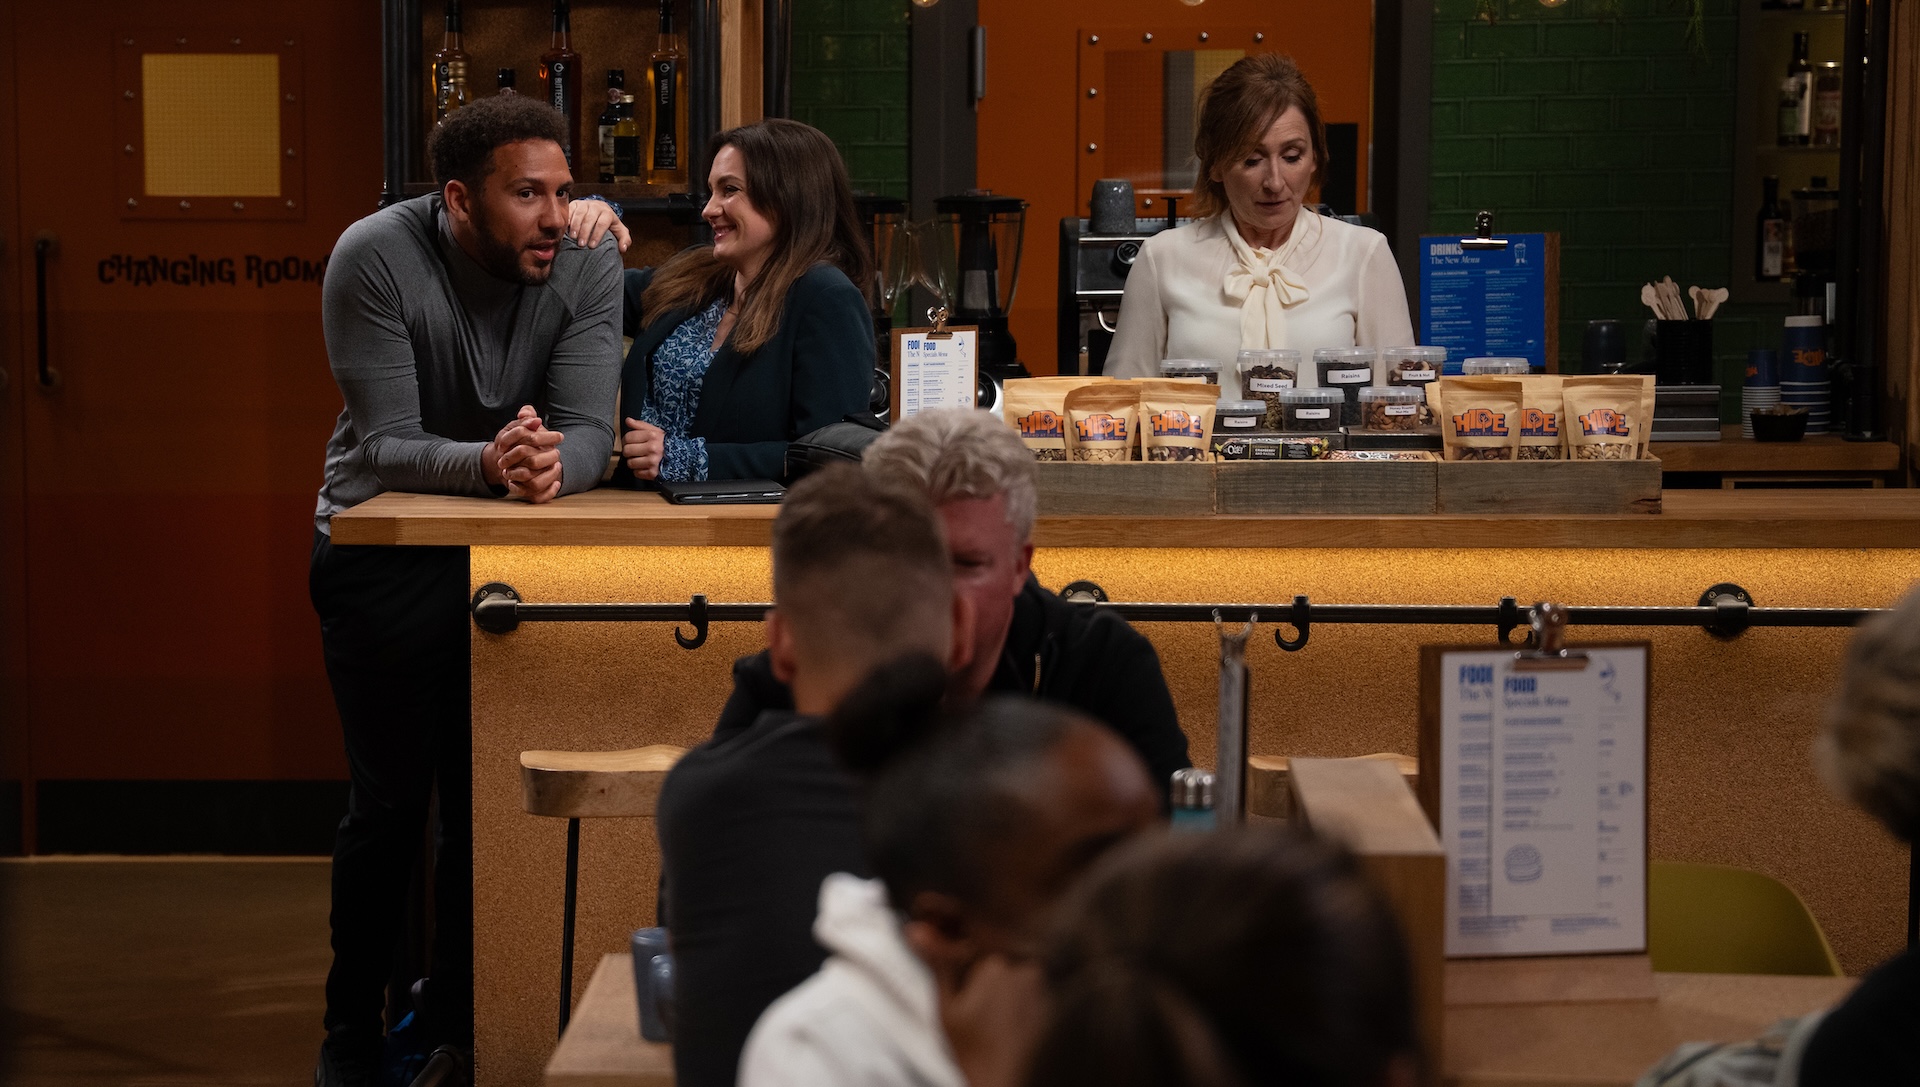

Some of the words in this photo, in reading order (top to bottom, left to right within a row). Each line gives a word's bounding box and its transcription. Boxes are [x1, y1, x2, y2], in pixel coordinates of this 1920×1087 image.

[554, 77, 563, 113] BUTTERSCO
[660, 78, 669, 104] VANILLA
[1430, 244, 1464, 256] DRINKS
[1430, 256, 1444, 264] The
[1445, 256, 1459, 264] New
[1460, 256, 1480, 264] Menu
[98, 253, 236, 288] CHANGING
[244, 253, 327, 288] ROOM
[924, 342, 936, 350] FOOD
[1076, 414, 1127, 437] HIDE
[1151, 410, 1203, 433] HIDE
[1453, 409, 1509, 432] HIDE
[1520, 408, 1558, 432] IDE
[1579, 409, 1629, 433] HIDE
[1504, 676, 1537, 693] FOOD
